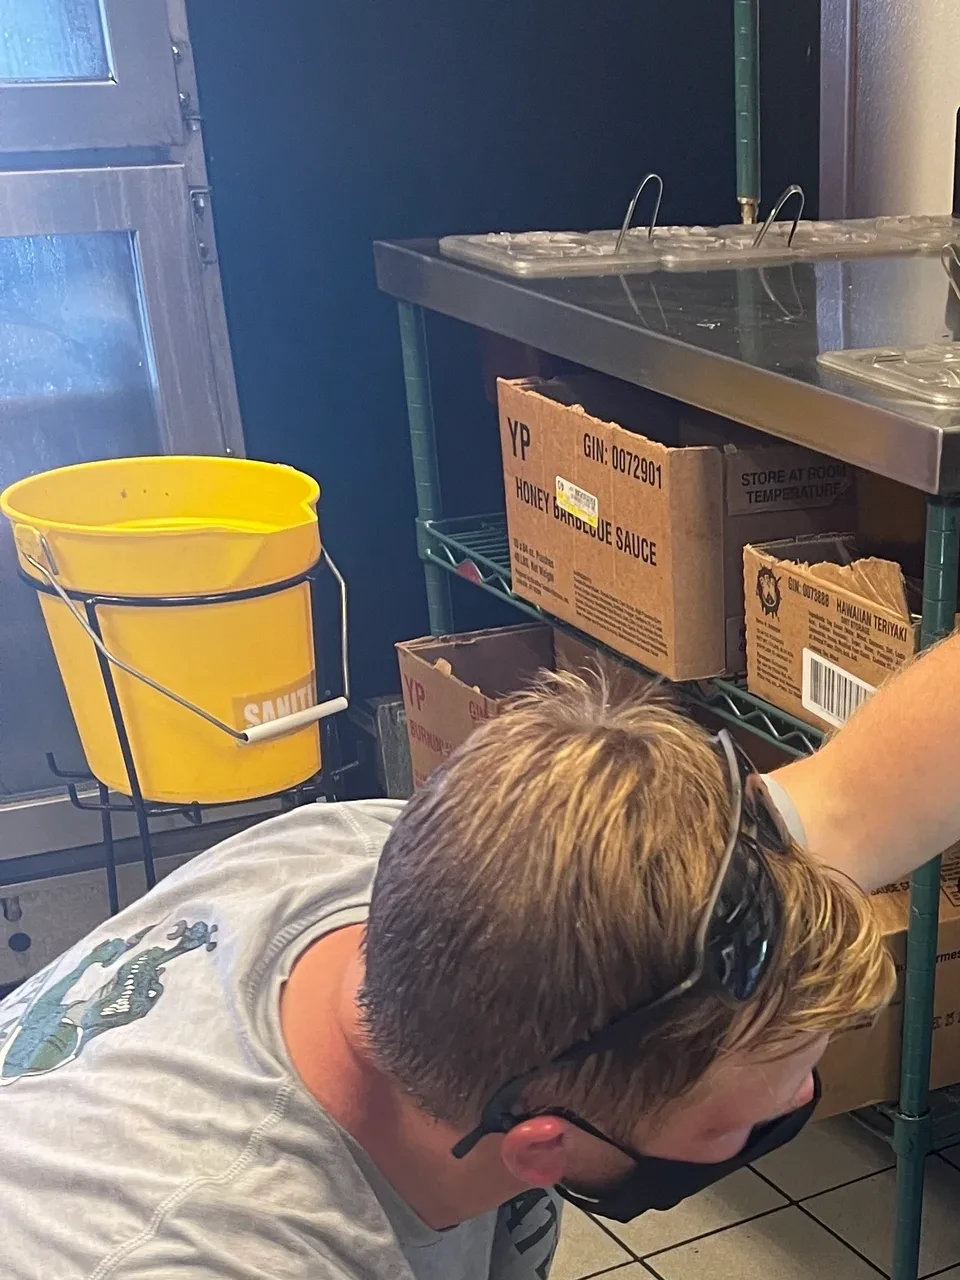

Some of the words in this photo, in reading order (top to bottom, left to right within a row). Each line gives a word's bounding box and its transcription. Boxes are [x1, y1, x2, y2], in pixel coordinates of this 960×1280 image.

[507, 416, 531, 461] YP
[583, 433, 608, 466] GIN:
[611, 445, 662, 489] 0072901
[741, 470, 785, 486] STORE
[788, 468, 804, 481] AT
[808, 464, 846, 479] ROOM
[746, 482, 844, 504] TEMPERATURE
[515, 476, 550, 515] HONEY
[615, 526, 657, 567] SAUCE
[836, 598, 872, 626] HAWAIIAN
[873, 614, 908, 643] TERIYAKI
[403, 673, 426, 712] YP
